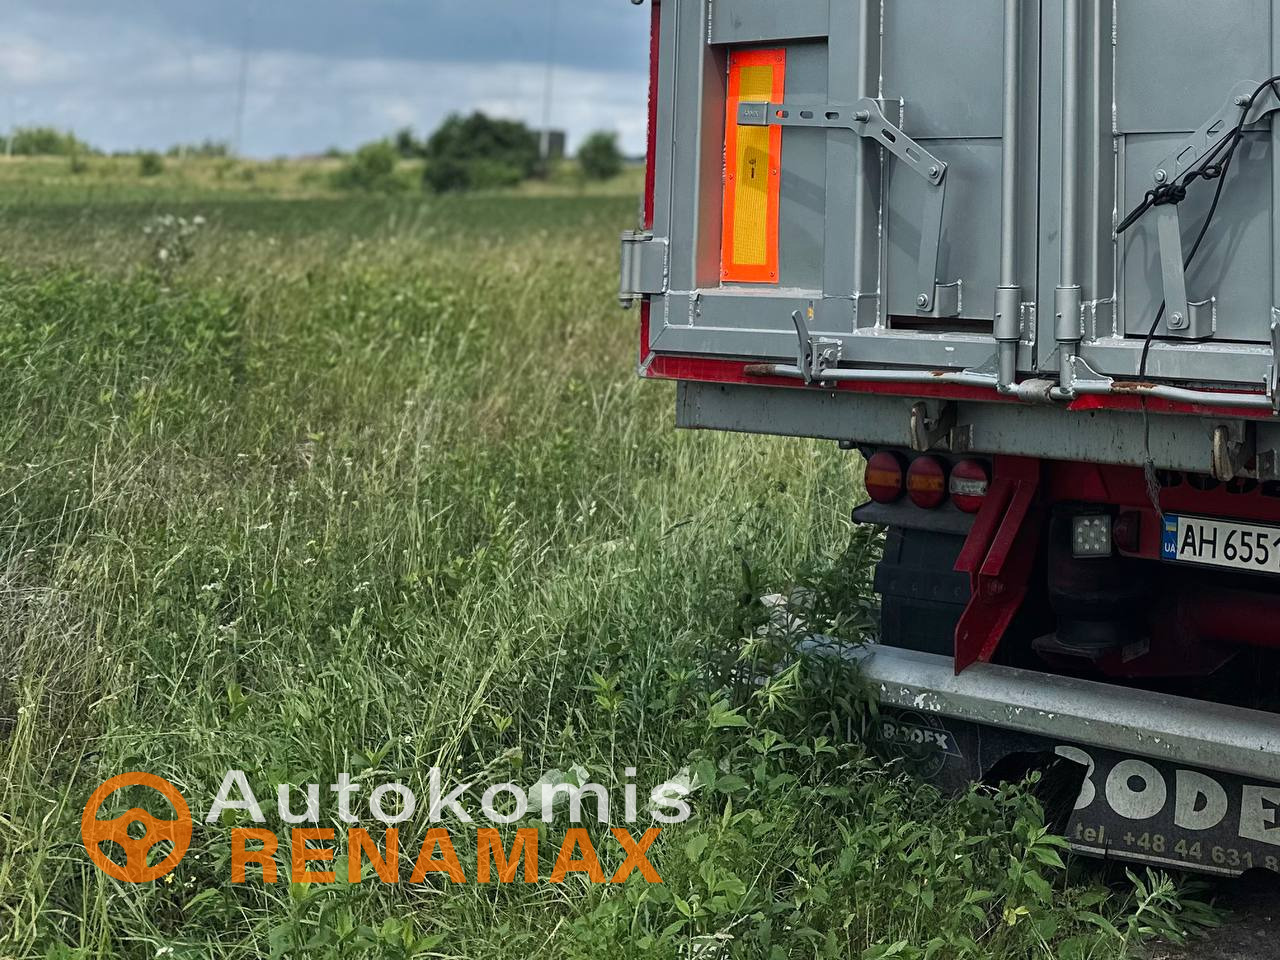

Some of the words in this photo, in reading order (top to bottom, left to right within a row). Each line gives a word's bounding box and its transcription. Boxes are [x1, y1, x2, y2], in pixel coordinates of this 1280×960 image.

[1164, 542, 1176, 553] UA
[1075, 822, 1112, 845] tel.
[1123, 831, 1165, 853] +48
[1174, 839, 1202, 859] 44
[1211, 845, 1253, 869] 631
